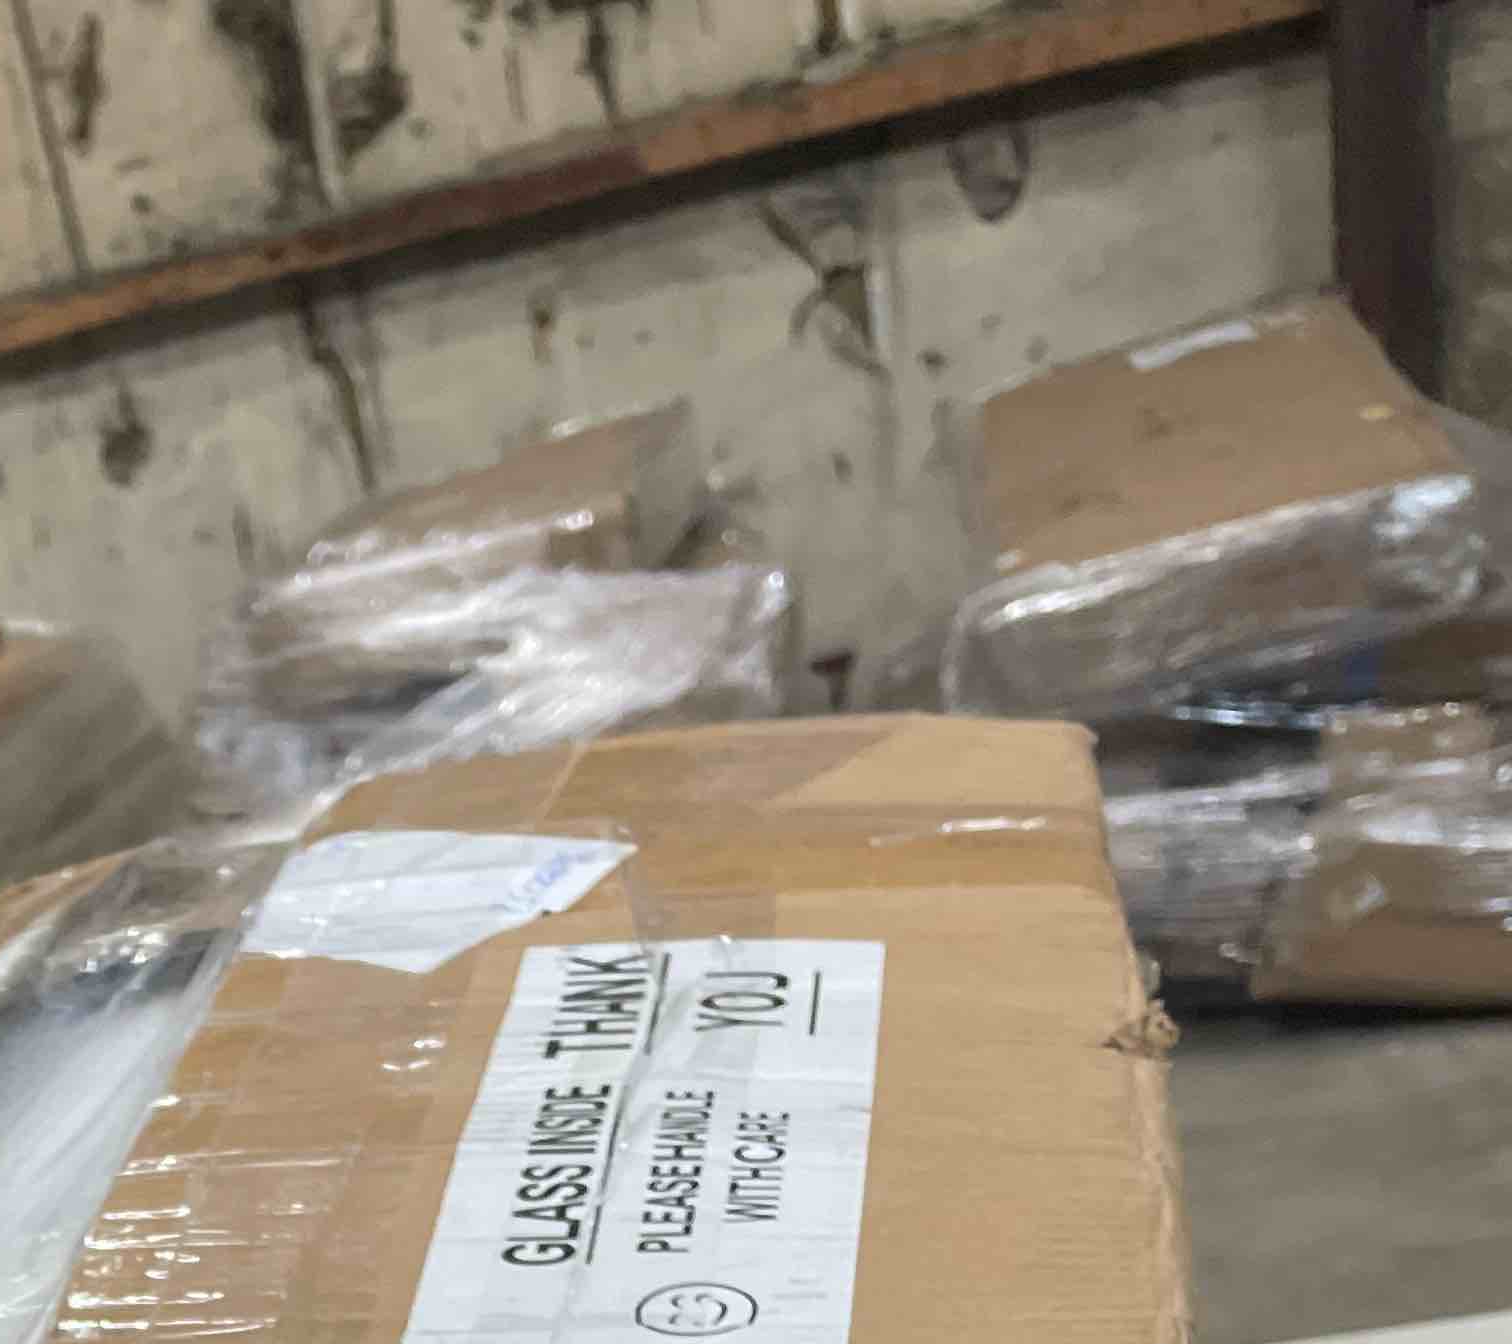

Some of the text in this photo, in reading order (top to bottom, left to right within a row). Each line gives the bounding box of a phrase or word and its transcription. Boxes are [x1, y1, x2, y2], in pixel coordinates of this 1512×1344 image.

[545, 953, 655, 1059] THANK
[501, 1084, 611, 1266] GLASS INSIDE
